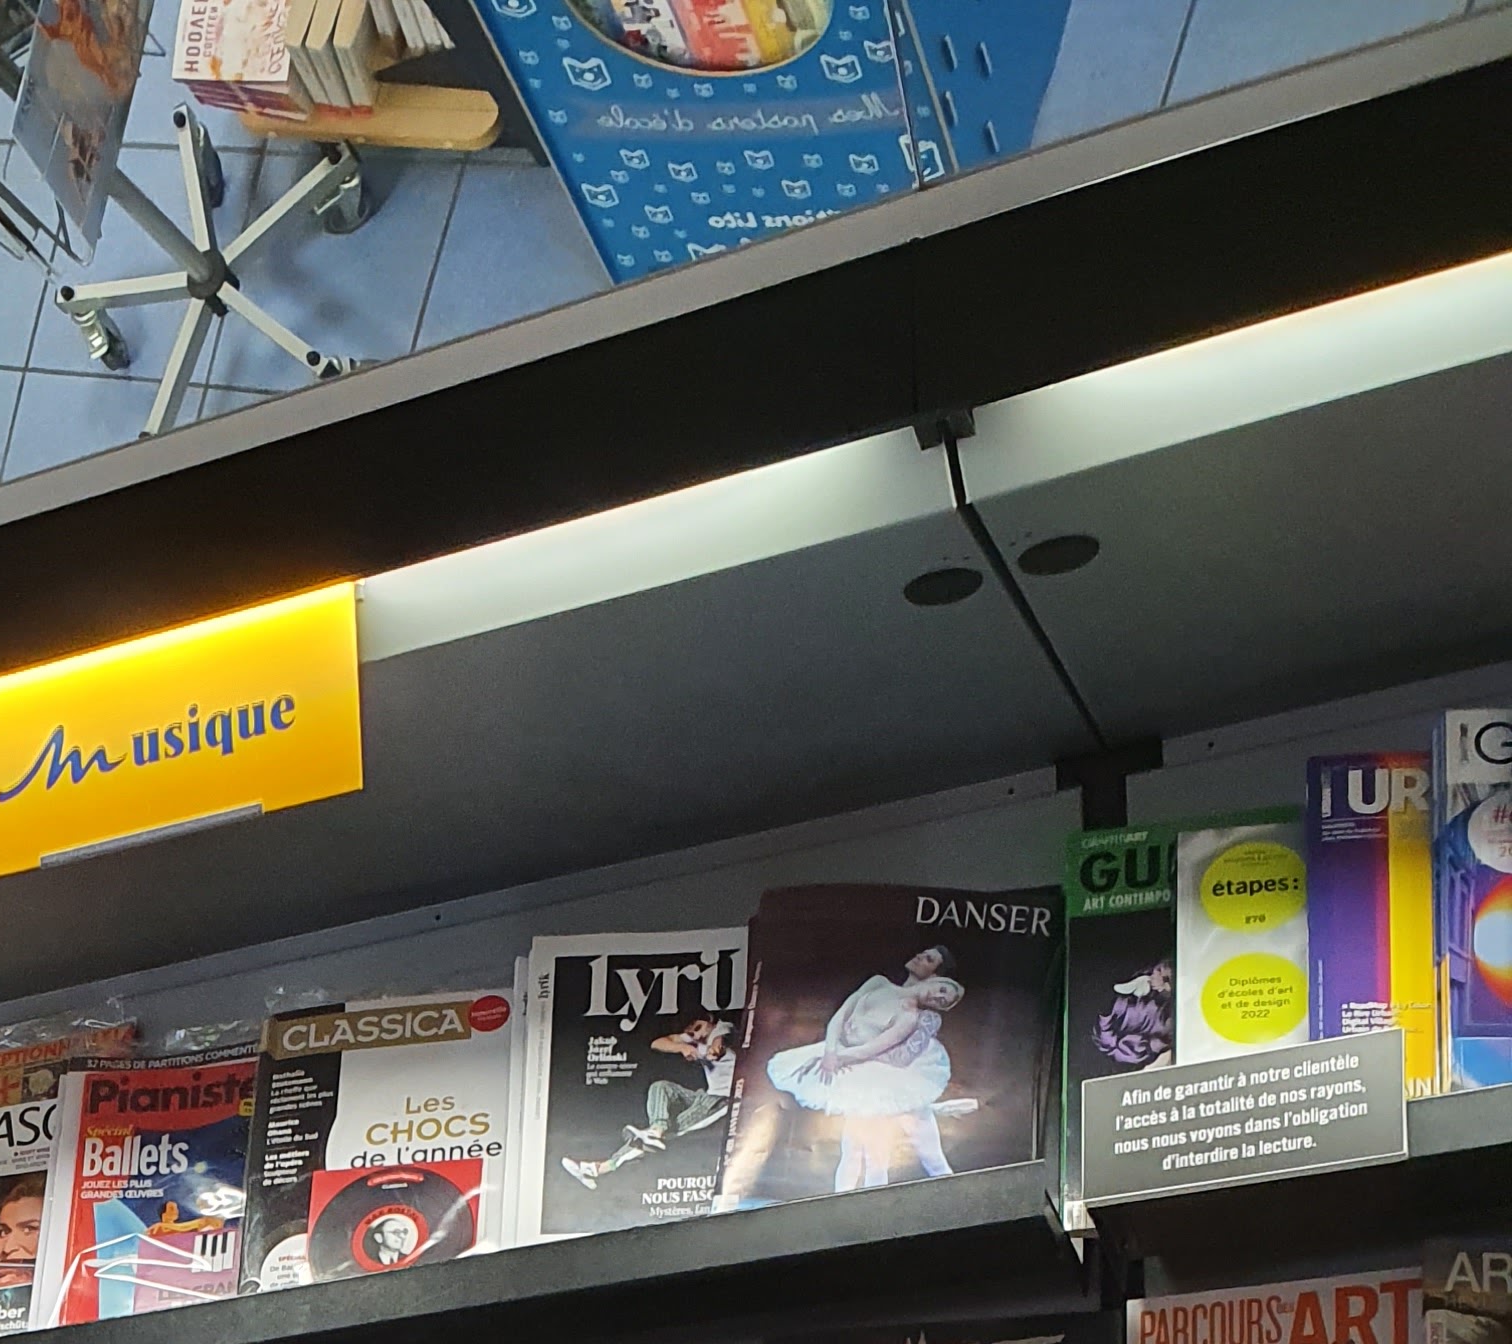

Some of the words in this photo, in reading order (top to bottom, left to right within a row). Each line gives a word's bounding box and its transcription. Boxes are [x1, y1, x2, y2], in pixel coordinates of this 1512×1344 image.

[915, 896, 1051, 937] DANSER
[282, 1009, 465, 1052] CLASSICA
[1240, 1008, 1271, 1020] 2022
[1122, 1086, 1151, 1107] Afin
[1154, 1085, 1172, 1101] de
[1175, 1074, 1234, 1100] garantir
[1238, 1072, 1247, 1087] à
[1250, 1066, 1290, 1086] notre
[1294, 1054, 1359, 1079] clientèle
[405, 1097, 455, 1114] Les
[1115, 1109, 1166, 1132] l'accès
[1170, 1106, 1179, 1122] à
[1183, 1104, 1195, 1120] la
[1200, 1094, 1254, 1118] totalité
[1258, 1090, 1277, 1107] de
[1280, 1088, 1306, 1103] nos
[1310, 1078, 1366, 1101] rayons,
[365, 1112, 491, 1146] CHOCS
[1115, 1137, 1149, 1154] nous
[1152, 1132, 1187, 1150] nous
[1190, 1123, 1241, 1145] voyons
[1245, 1117, 1281, 1134] dans
[1284, 1101, 1368, 1128] l'obligation
[82, 1133, 188, 1177] Ballets
[1162, 1147, 1238, 1171] d'interdire
[1242, 1143, 1255, 1158] la
[1259, 1134, 1317, 1156] lecture.
